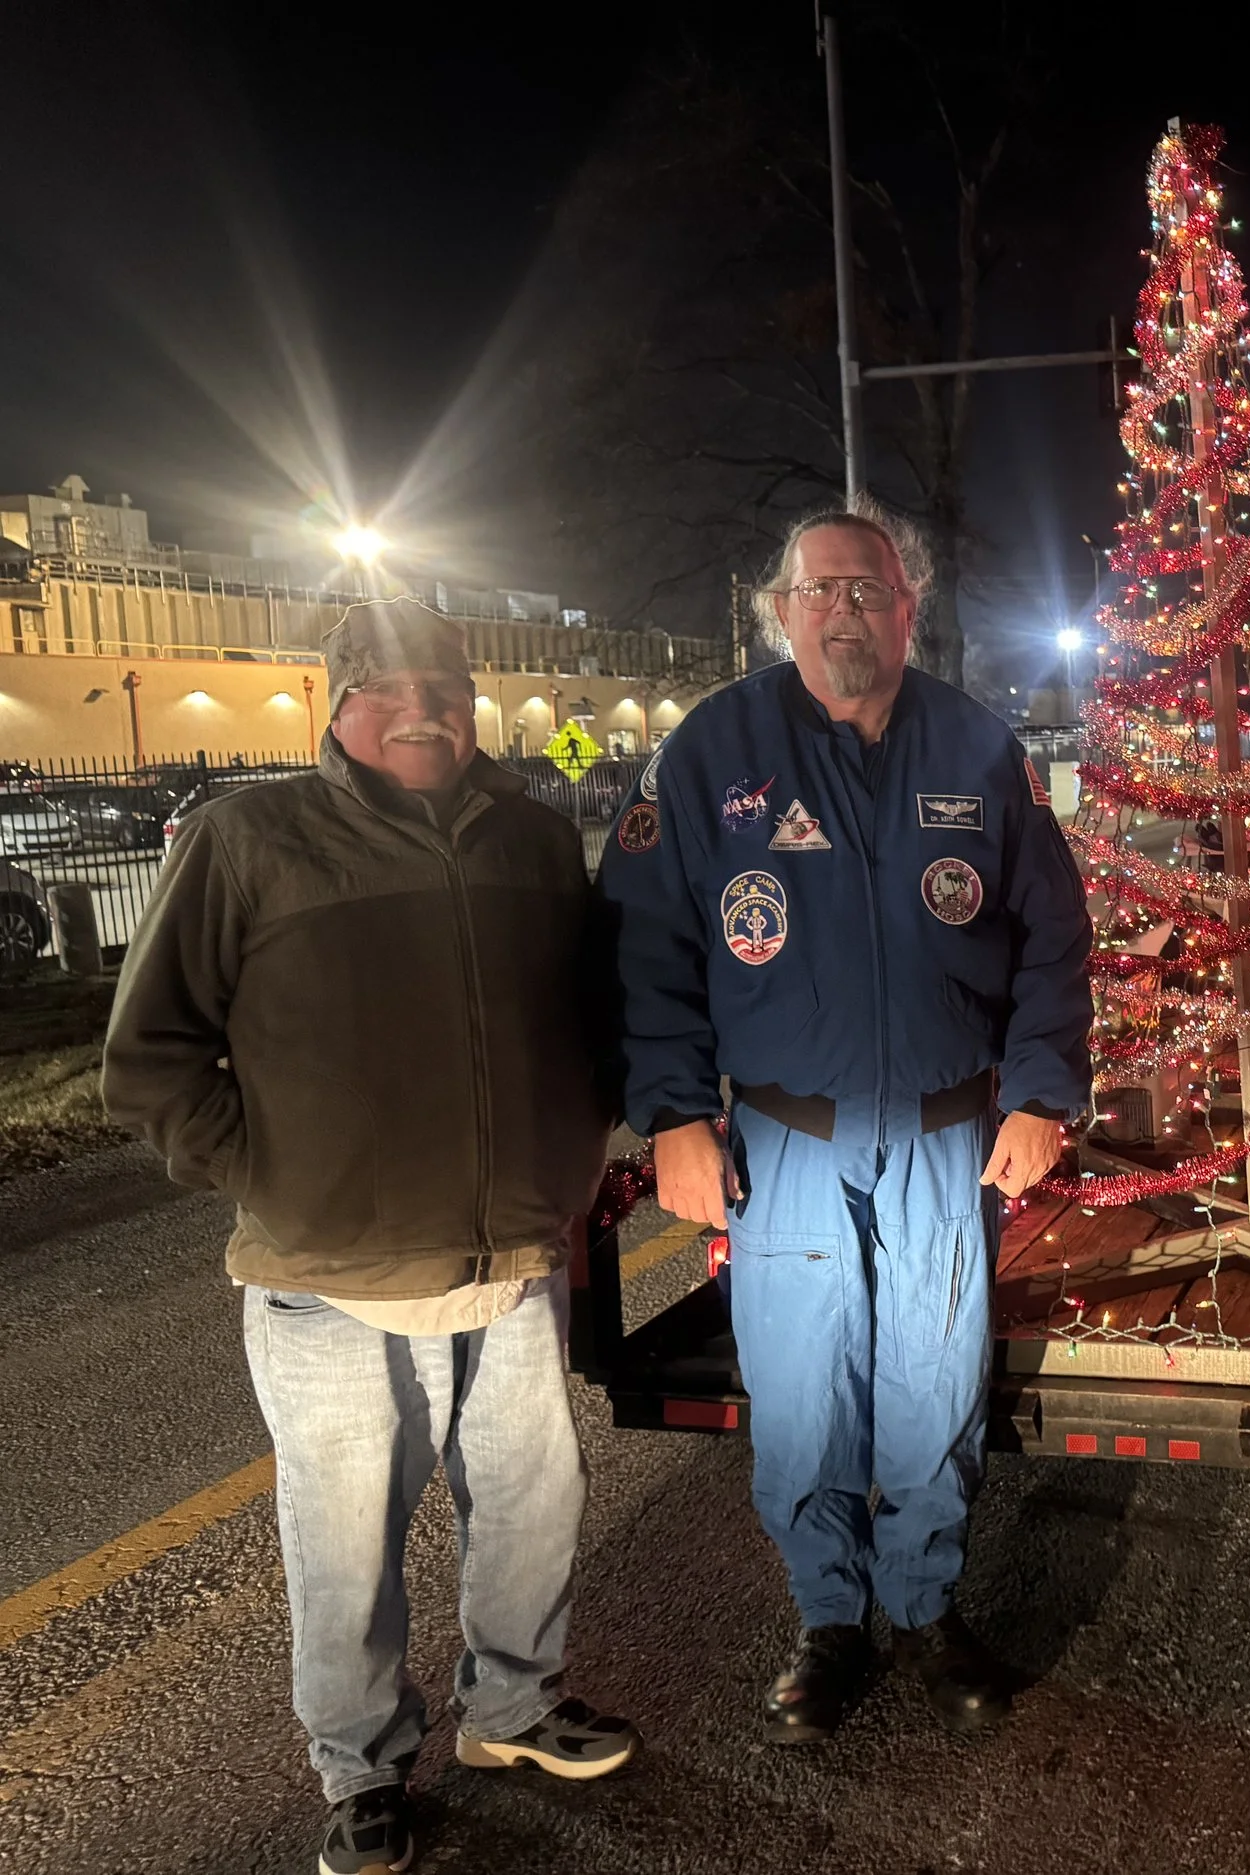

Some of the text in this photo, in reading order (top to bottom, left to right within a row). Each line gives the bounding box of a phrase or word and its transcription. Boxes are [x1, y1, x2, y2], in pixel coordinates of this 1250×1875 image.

[721, 794, 767, 816] NASA
[927, 861, 977, 881] ROCKET
[729, 875, 776, 896] SPACE CAMP
[728, 898, 782, 936] ADVANCED SPACE ACADEMY
